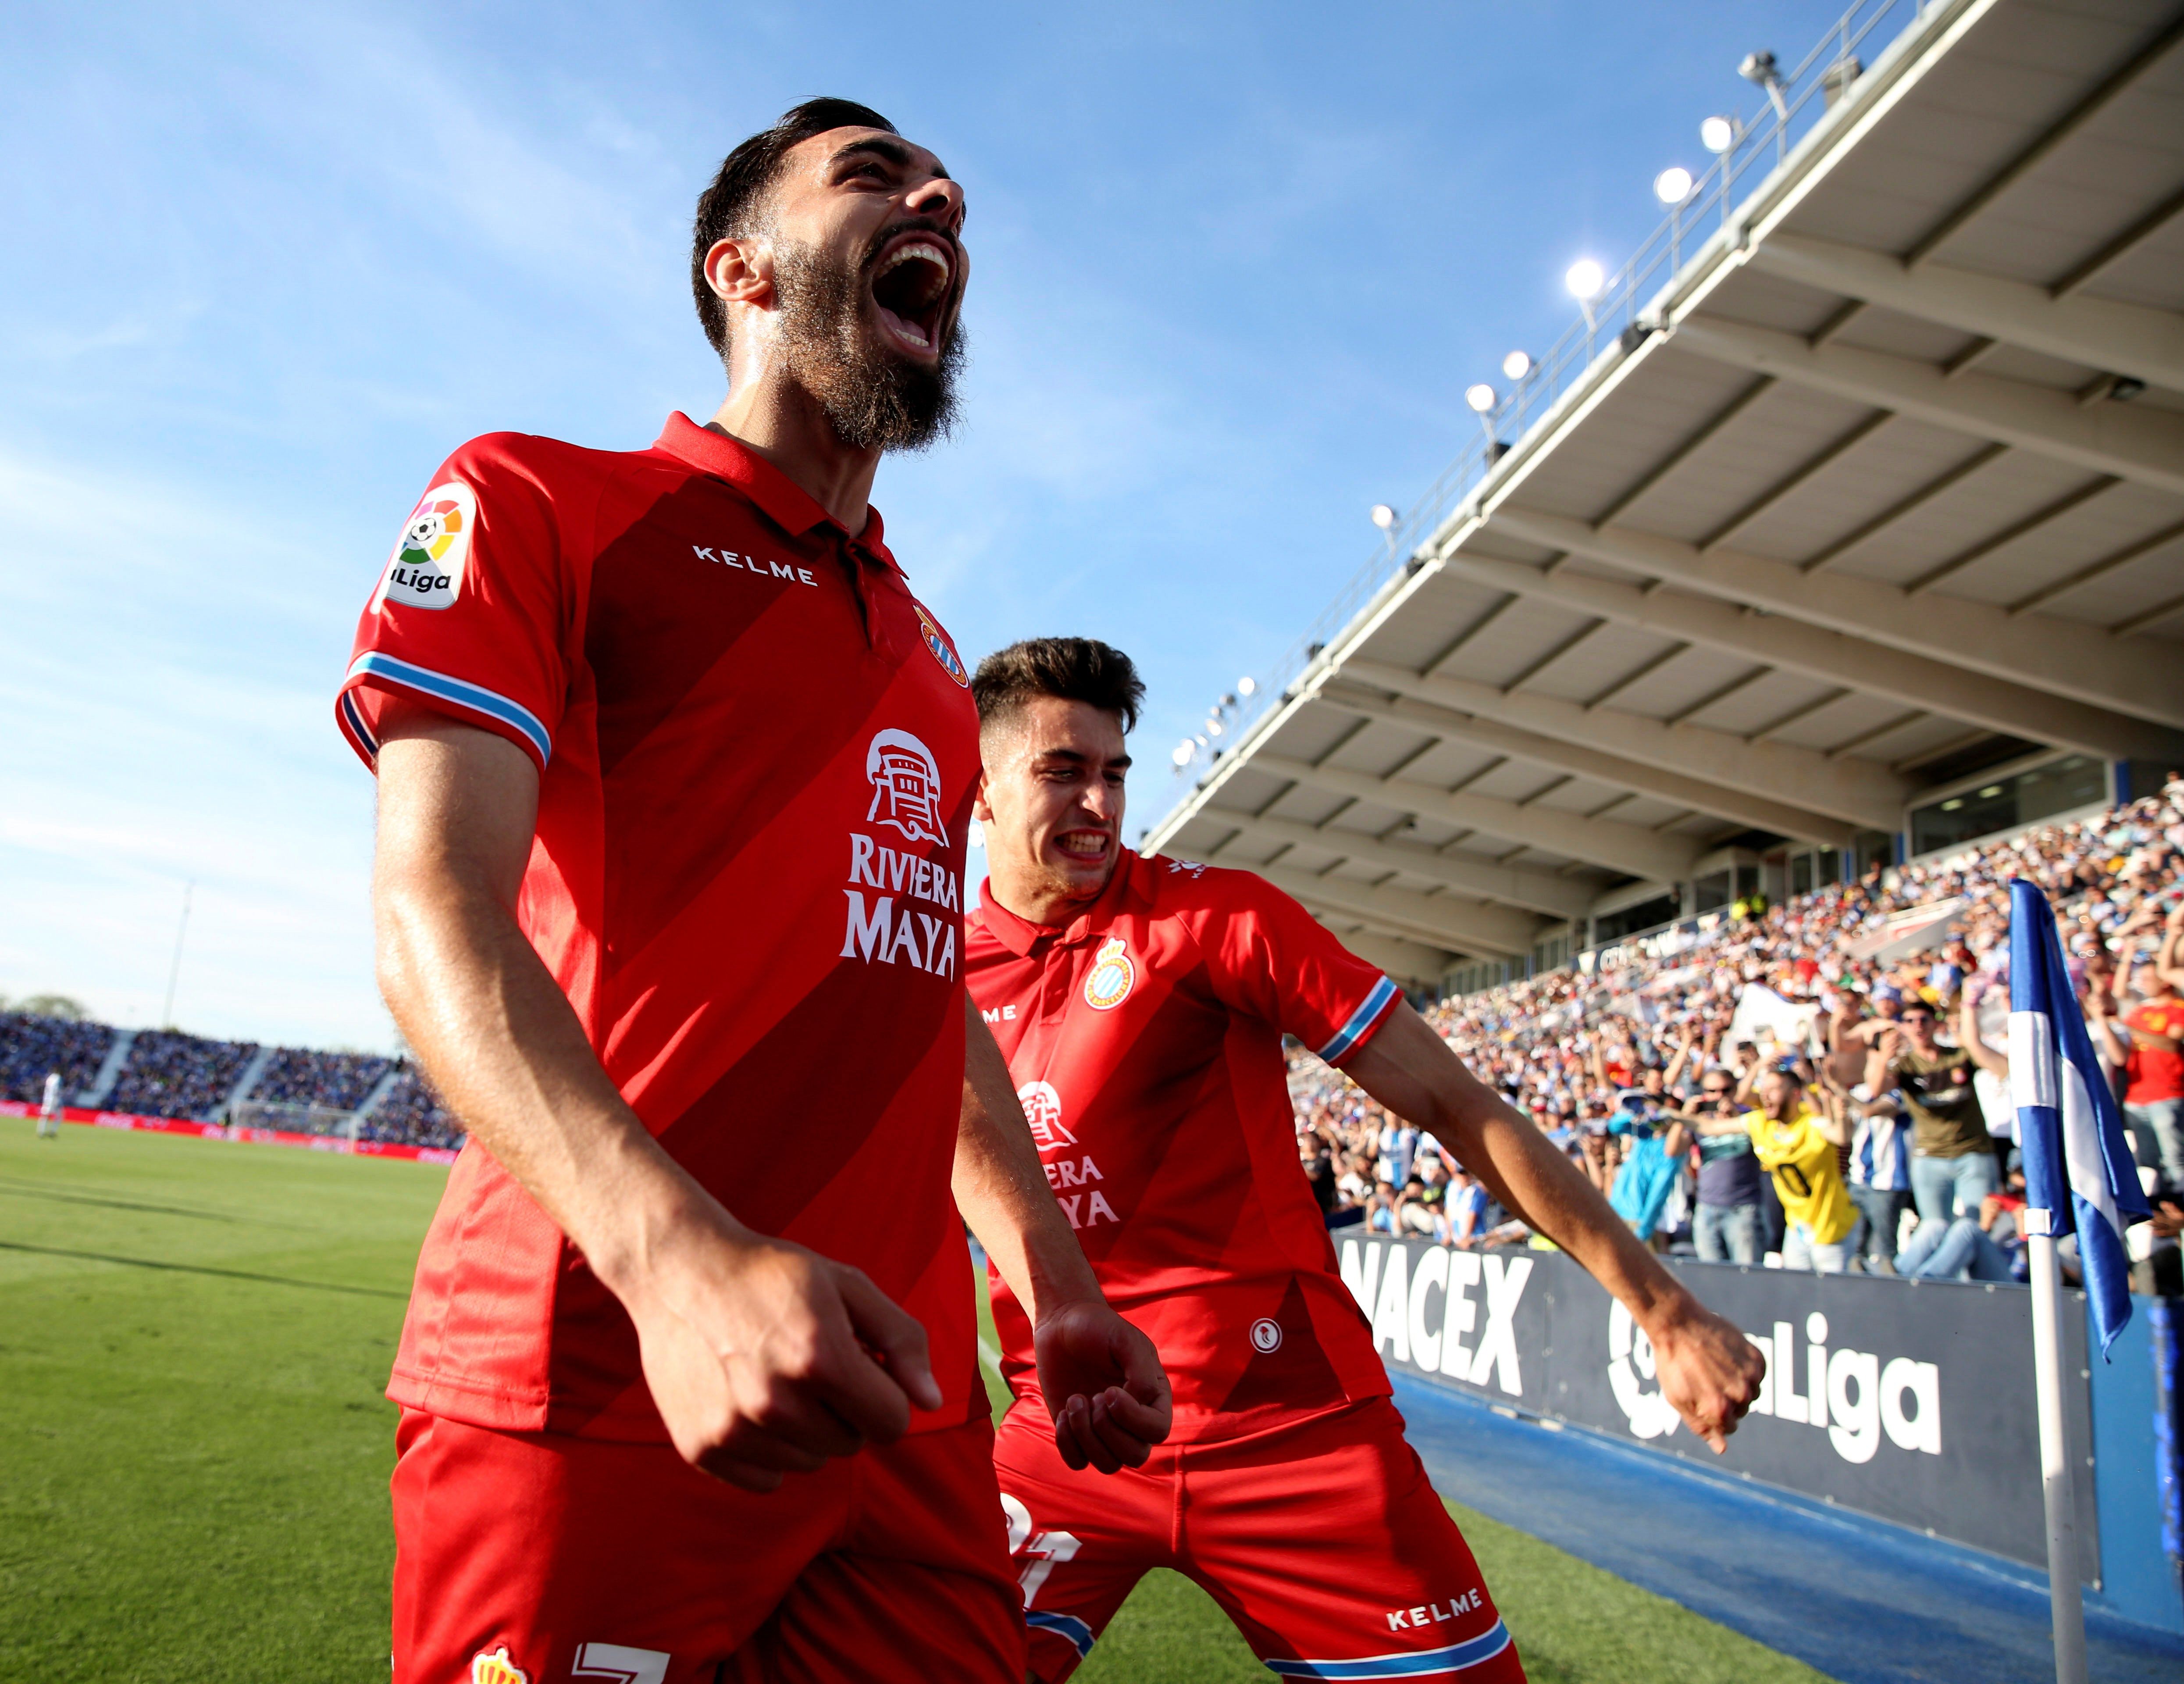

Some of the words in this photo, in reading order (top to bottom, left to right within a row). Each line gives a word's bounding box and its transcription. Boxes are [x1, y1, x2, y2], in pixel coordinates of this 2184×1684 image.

[692, 545, 818, 587] KELME
[847, 832, 958, 914] RIVIERA
[838, 889, 955, 983] MAYA
[1340, 1238, 1534, 1397] NACEX
[1386, 1587, 1482, 1631] KELME
